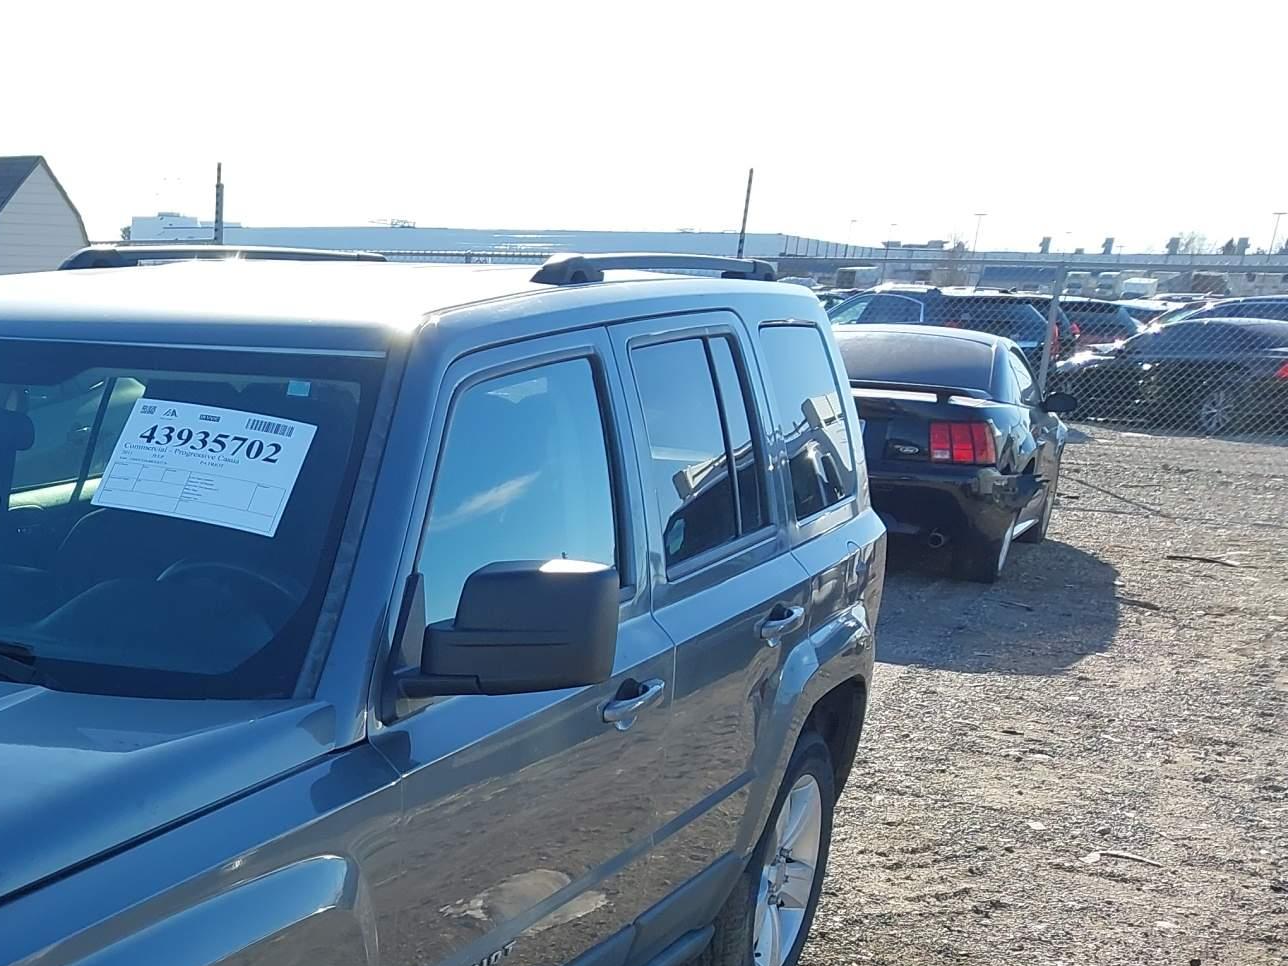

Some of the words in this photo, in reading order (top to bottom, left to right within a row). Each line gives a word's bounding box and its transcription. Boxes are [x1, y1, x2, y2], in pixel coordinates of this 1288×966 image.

[124, 442, 168, 453] Commercial
[174, 448, 217, 460] Progressive
[139, 424, 281, 463] 43935702
